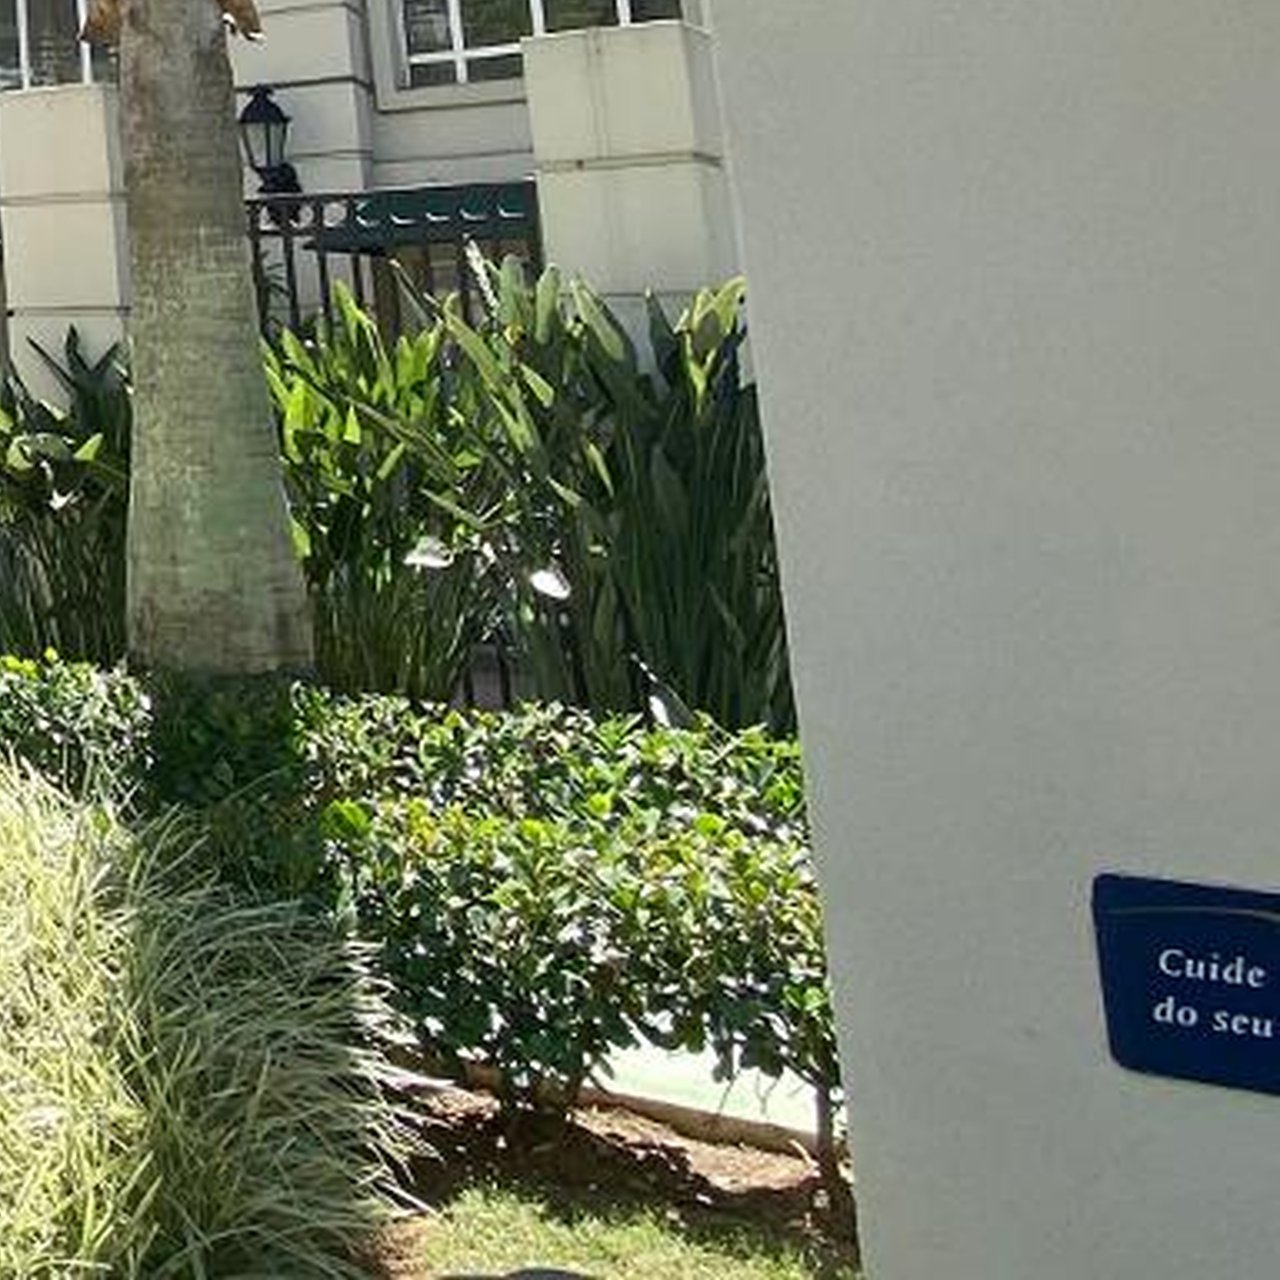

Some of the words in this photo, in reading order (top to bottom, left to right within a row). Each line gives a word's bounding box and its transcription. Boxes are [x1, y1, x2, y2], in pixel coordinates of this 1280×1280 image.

[1158, 948, 1266, 988] Cuide
[1152, 996, 1198, 1028] do
[1212, 1009, 1273, 1038] seu
